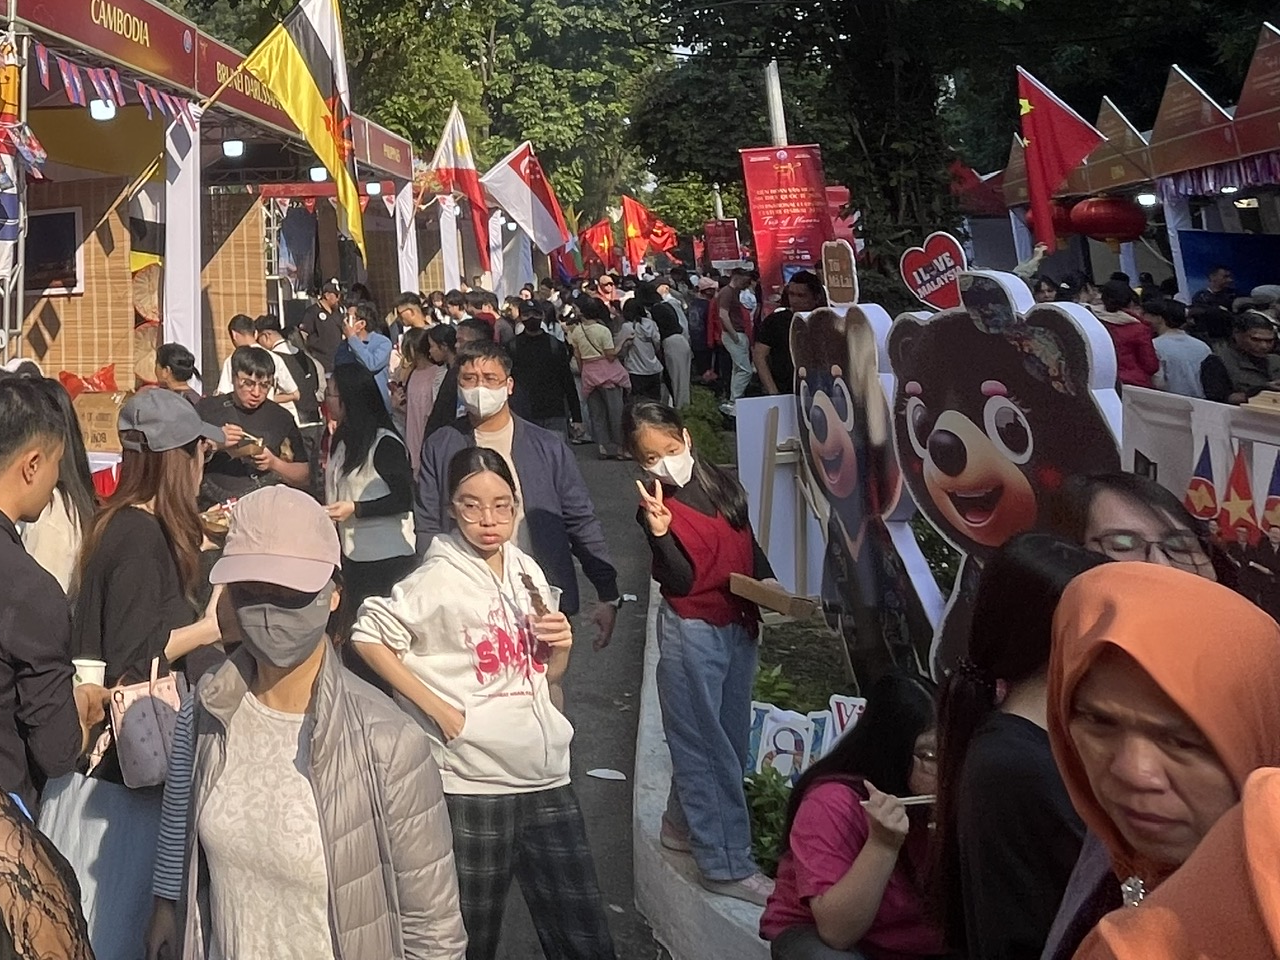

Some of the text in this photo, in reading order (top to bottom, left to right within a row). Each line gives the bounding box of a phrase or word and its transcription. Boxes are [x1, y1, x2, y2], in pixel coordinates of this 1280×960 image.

[912, 251, 955, 285] I LOVE
[917, 266, 964, 299] MALAYSIA
